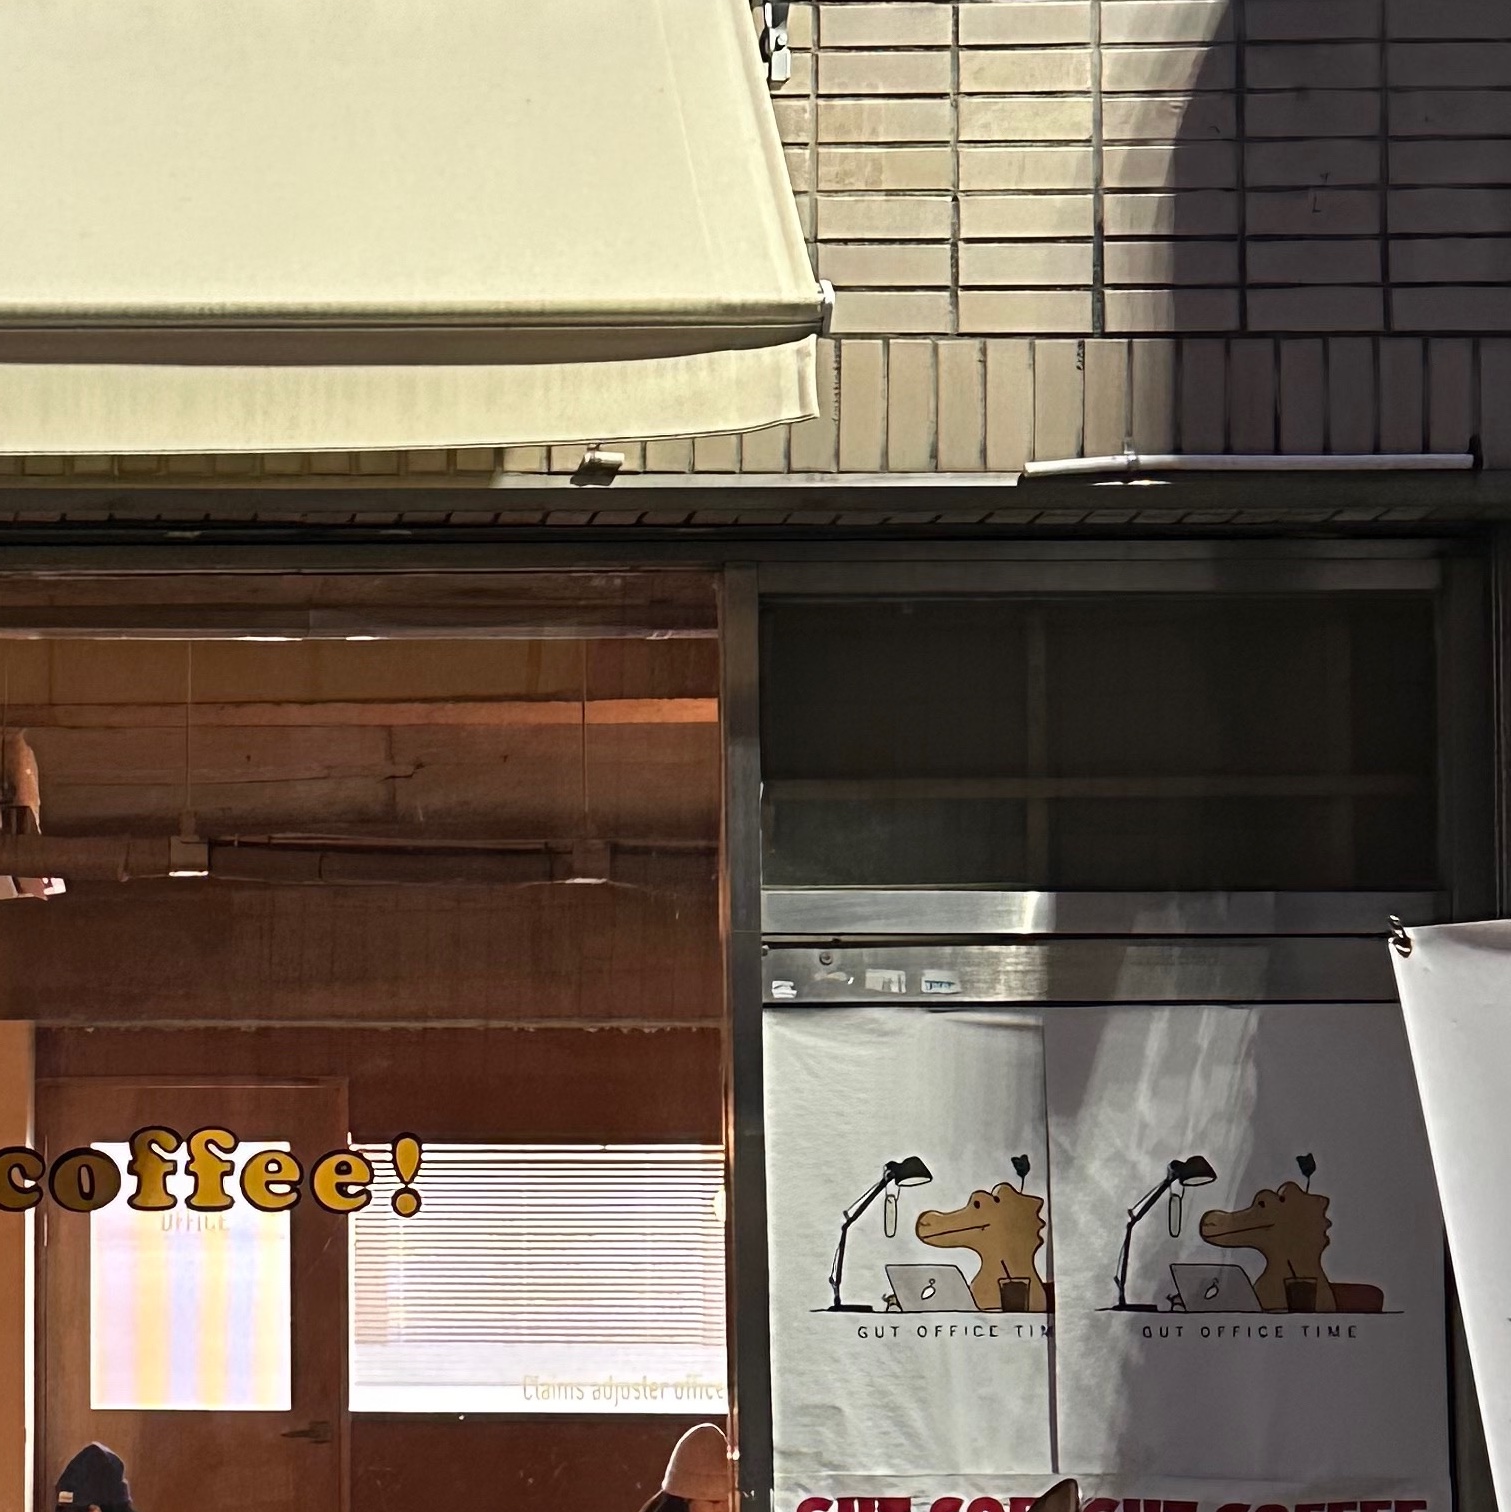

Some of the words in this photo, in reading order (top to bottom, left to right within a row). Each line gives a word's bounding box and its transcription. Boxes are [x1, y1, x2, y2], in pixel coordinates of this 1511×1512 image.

[857, 1325, 900, 1339] GUT
[916, 1324, 999, 1338] OFFICE
[1142, 1325, 1184, 1339] GUT
[1200, 1325, 1284, 1339] OFFICE
[1301, 1325, 1358, 1339] TIME
[522, 1374, 585, 1400] Claims
[592, 1374, 669, 1407] adjuster
[674, 1373, 724, 1400] office
